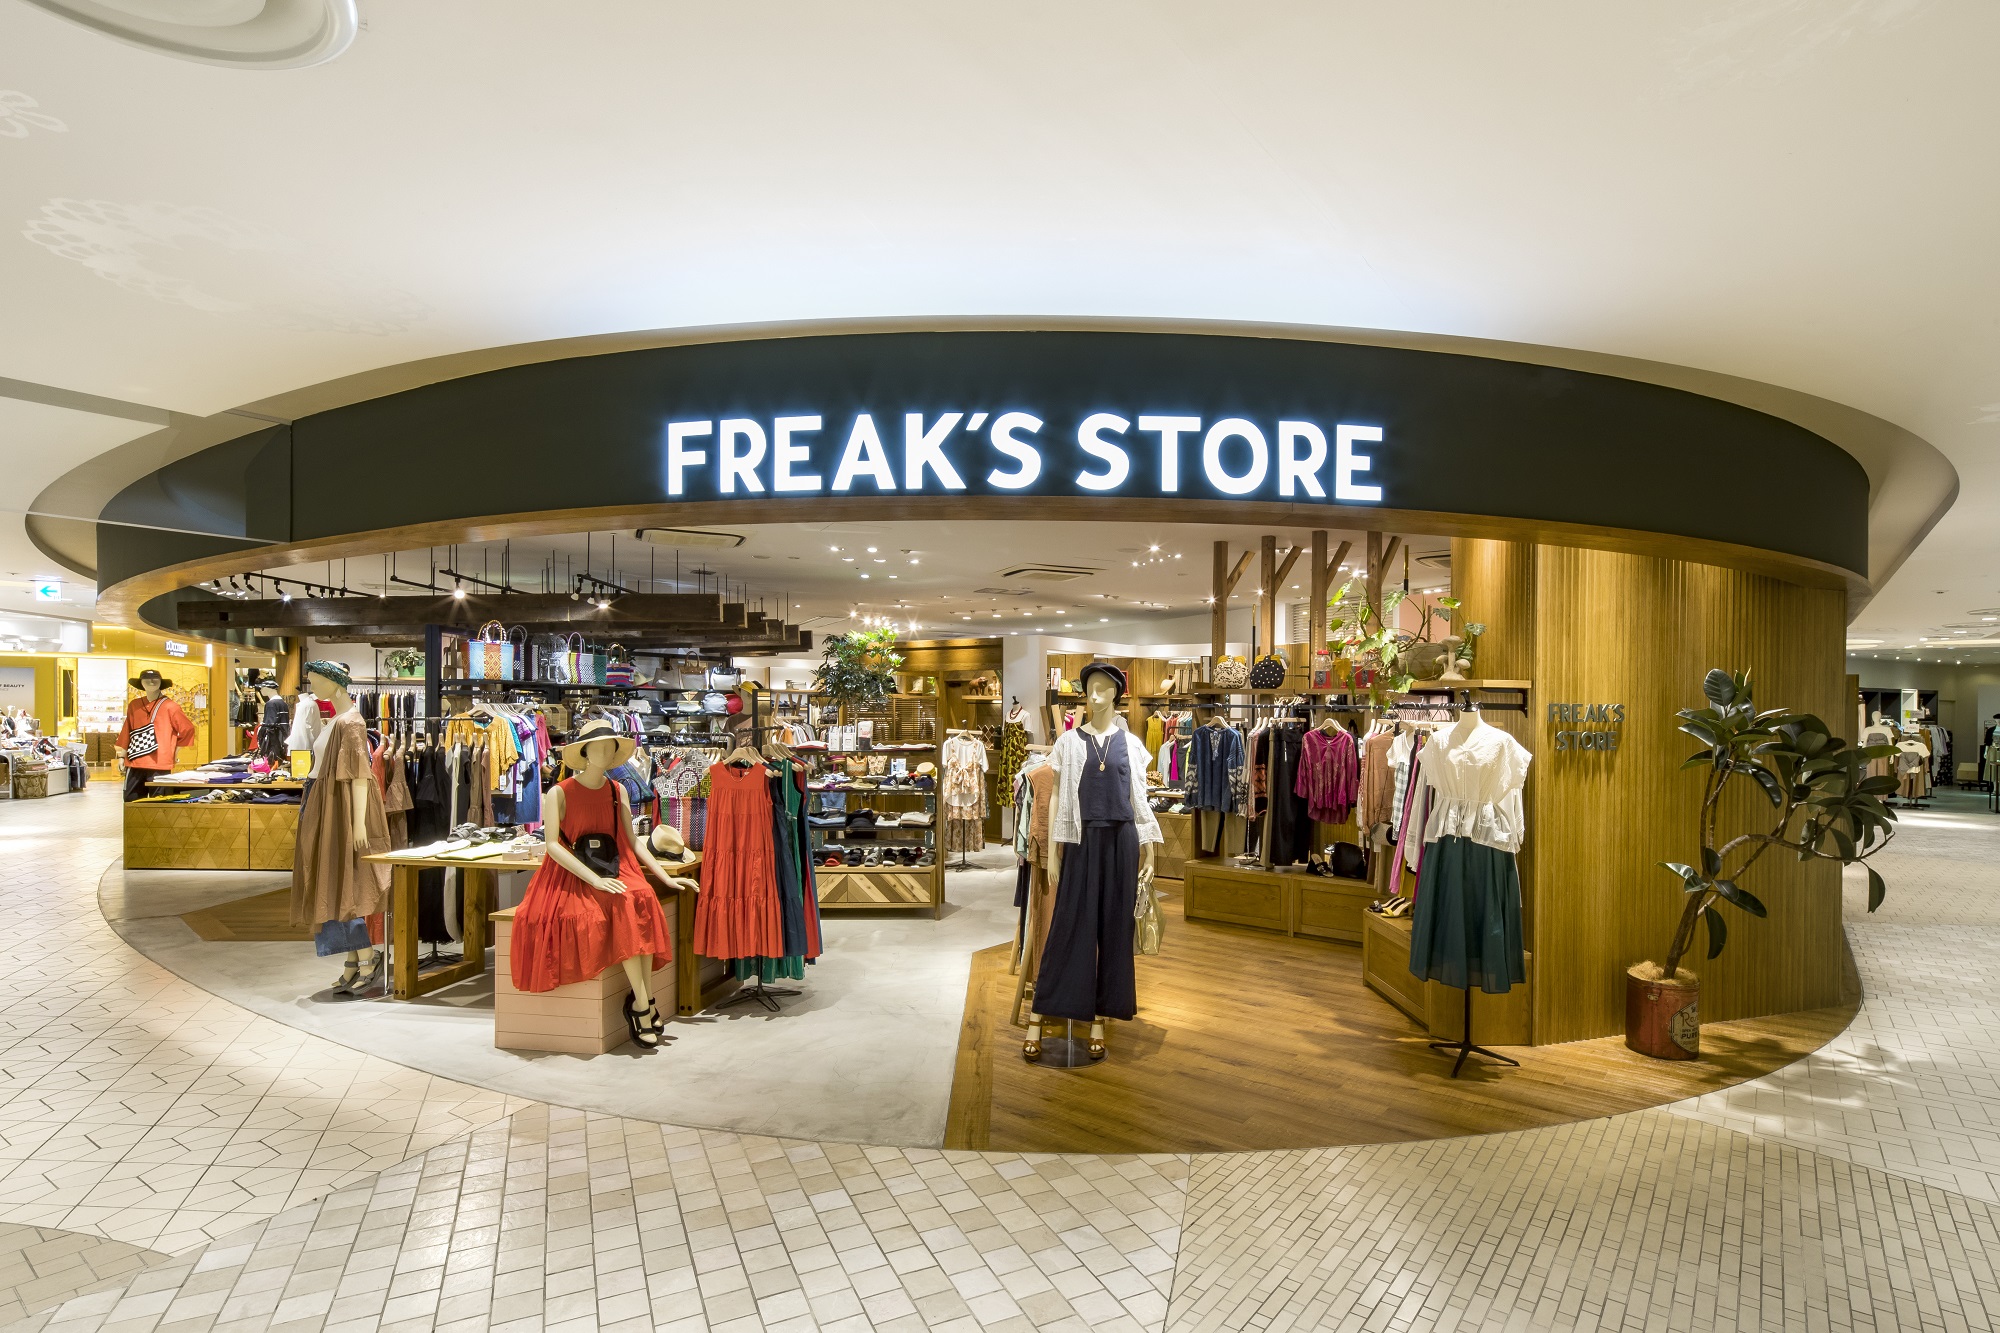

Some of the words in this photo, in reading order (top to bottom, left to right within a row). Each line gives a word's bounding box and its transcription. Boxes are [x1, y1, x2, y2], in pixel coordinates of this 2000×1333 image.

[668, 412, 1043, 495] FREAK'S
[1075, 412, 1383, 500] STORE
[1547, 703, 1625, 722] FREAK'S
[1556, 731, 1617, 750] STORE
